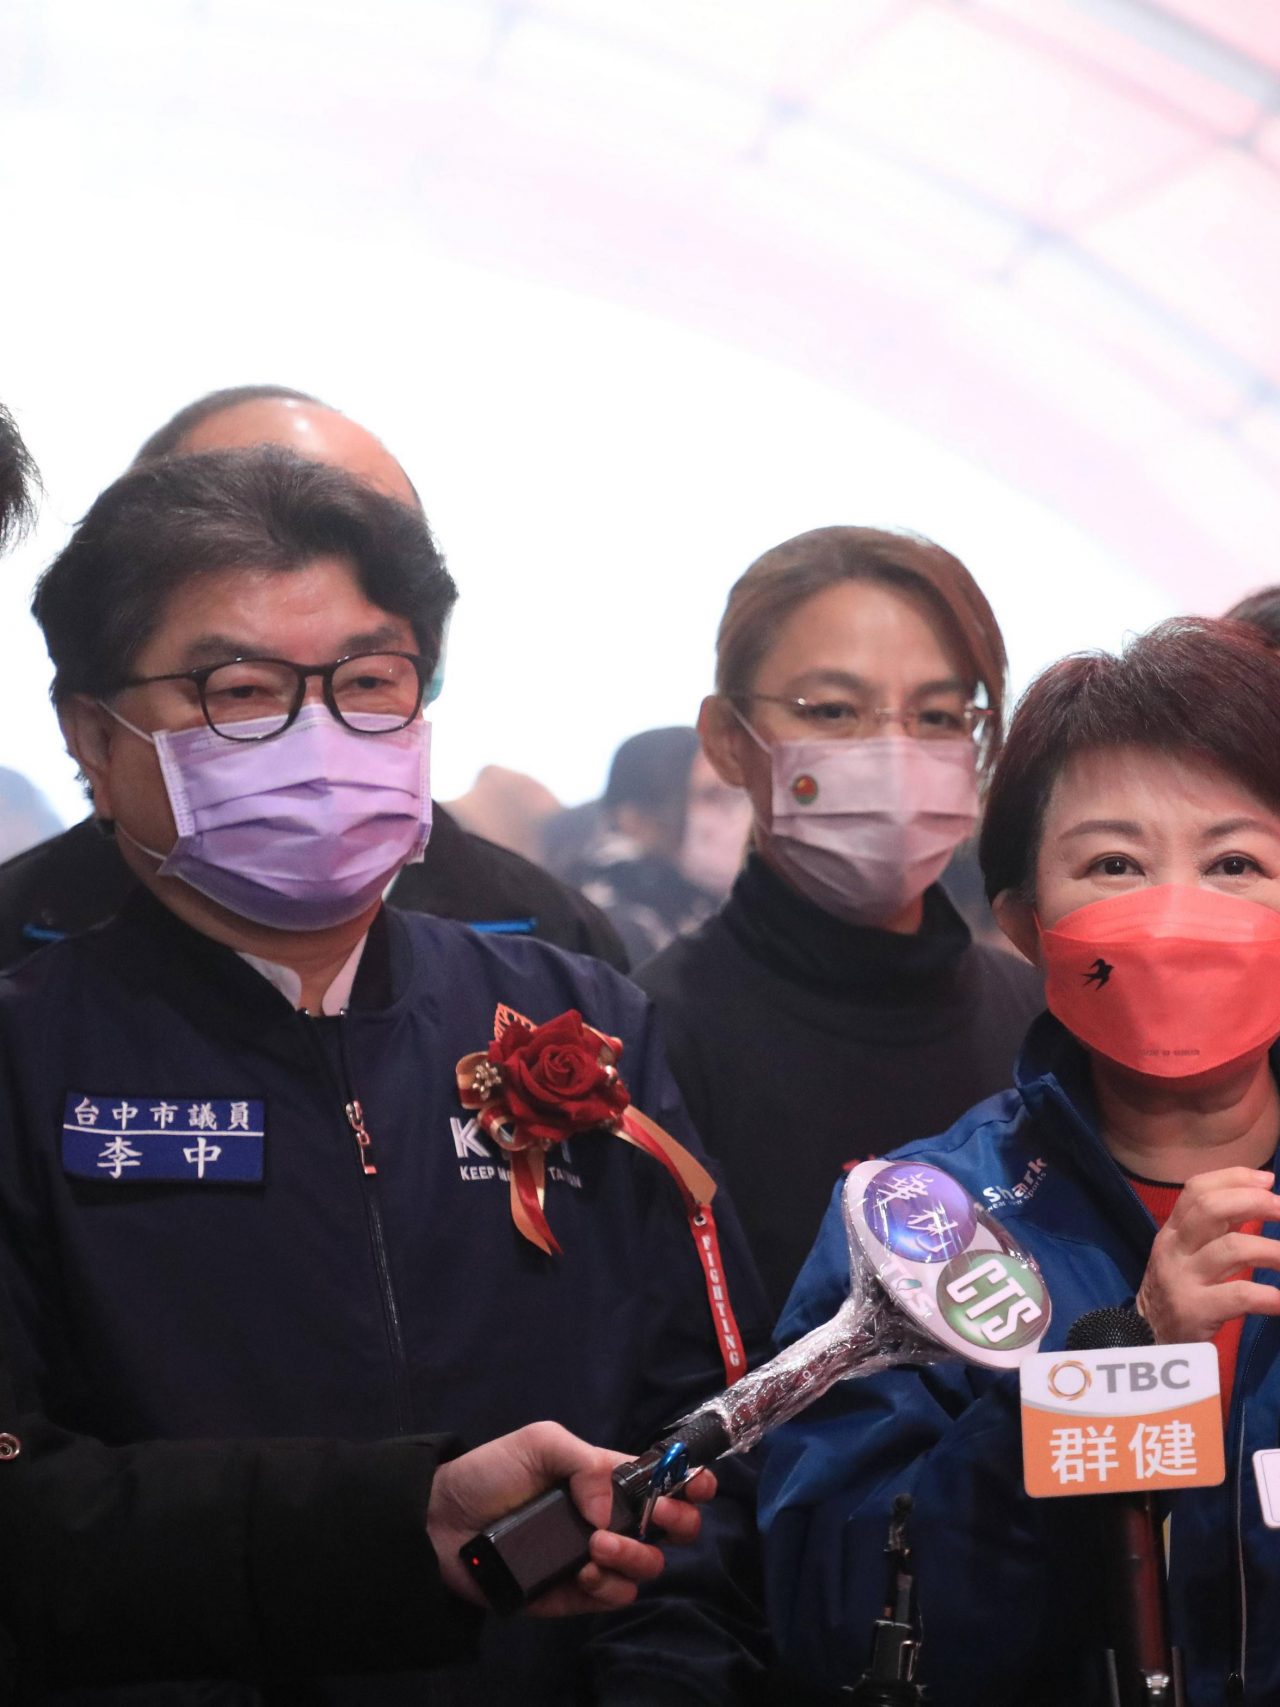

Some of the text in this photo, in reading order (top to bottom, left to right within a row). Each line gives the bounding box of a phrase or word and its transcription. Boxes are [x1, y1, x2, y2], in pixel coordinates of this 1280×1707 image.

[75, 1097, 249, 1131] 台中市議員
[460, 1165, 495, 1181] KEEP
[983, 1158, 1047, 1203] Shark
[701, 1234, 739, 1367] FIGHTING
[946, 1259, 1042, 1343] CTS
[1096, 1359, 1190, 1393] TBC
[1050, 1420, 1197, 1485] 群健
